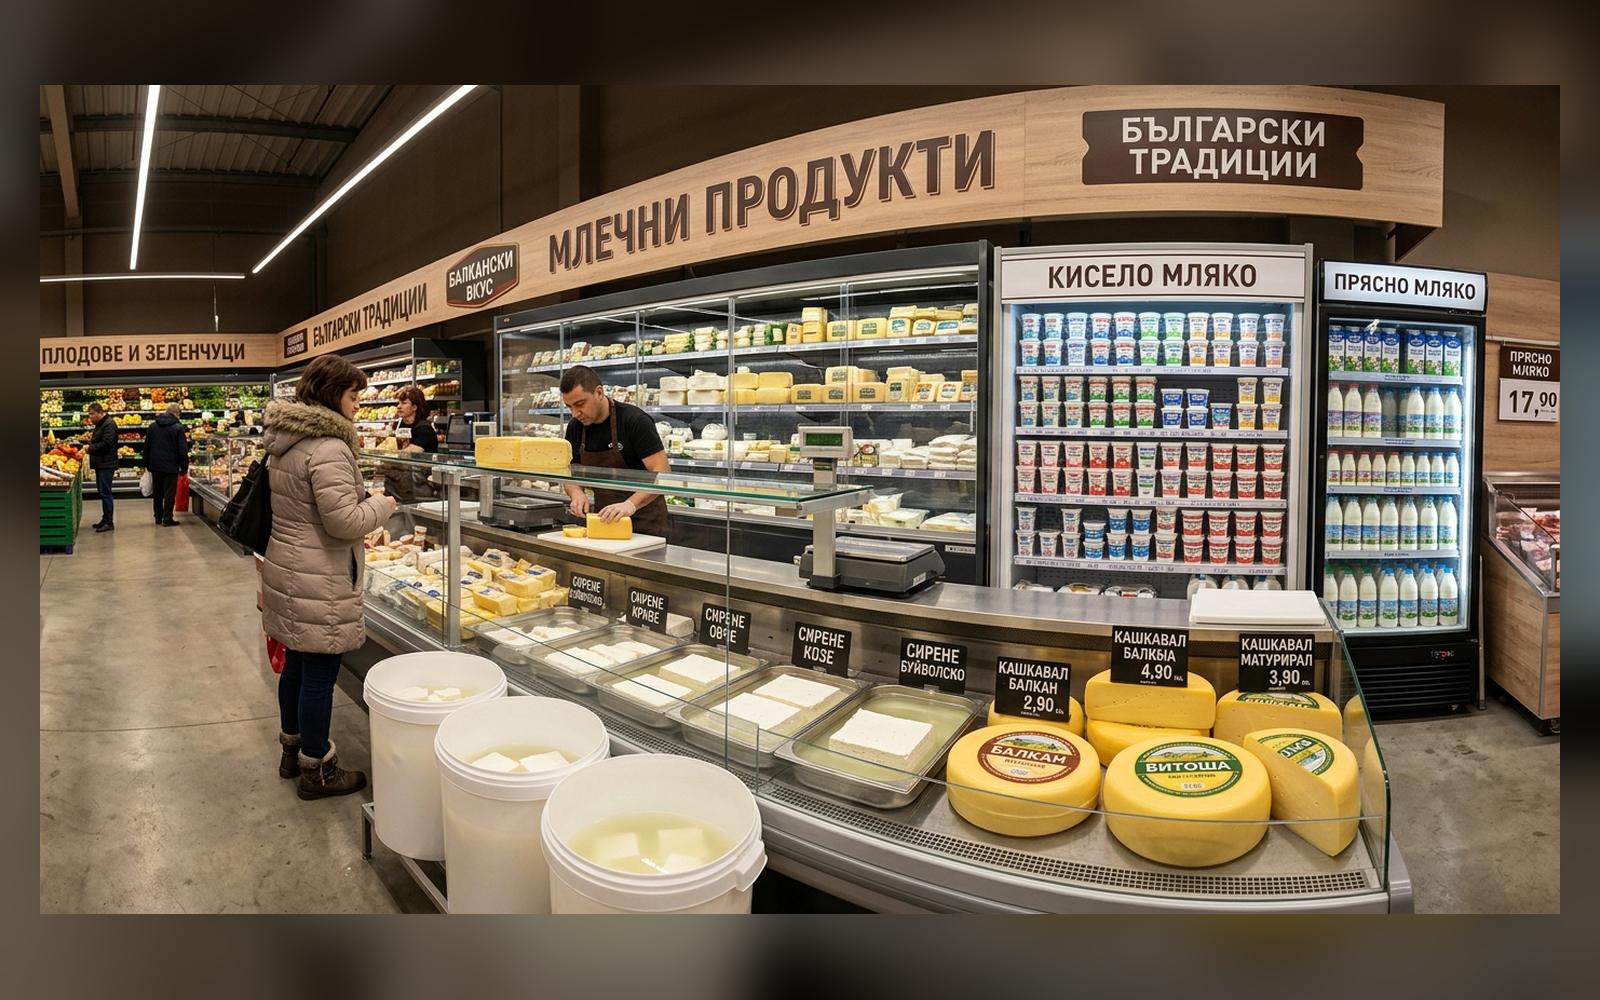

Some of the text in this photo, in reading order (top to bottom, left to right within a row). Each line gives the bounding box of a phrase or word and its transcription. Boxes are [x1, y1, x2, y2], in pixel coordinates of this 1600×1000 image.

[1121, 116, 1326, 147] БЪЛГАРСКИ
[1128, 148, 1318, 181] ТРАДИЦИИ
[548, 129, 996, 274] МЛЕЧНИ ПРОДУКТИ
[1048, 263, 1258, 289] КИСЕЛО МЛЯКО
[1334, 273, 1477, 301] ПРЯСНО МЛЯКО
[466, 278, 495, 302] ВКУС
[362, 282, 428, 330] ТРАДИЦИИ
[41, 342, 246, 367] ПЛОДОВЕ И ЗЕЛЕНЧУЦИ
[1114, 630, 1187, 648] КАШКАВАЛ
[1241, 638, 1313, 651] КАШКАВАЛ
[906, 642, 960, 665] СИРЕНЕ
[1240, 653, 1313, 667] МАТУРИРАЛ
[900, 659, 966, 682] БУЙВОЛСКО
[998, 660, 1069, 681] КАШКАВАЛ
[1141, 663, 1173, 680] 4,90
[1269, 669, 1300, 686] 3,90
[1008, 677, 1058, 695] БАЛКАН
[1023, 695, 1055, 713] 2,90
[1145, 760, 1231, 773] ВИТОША
